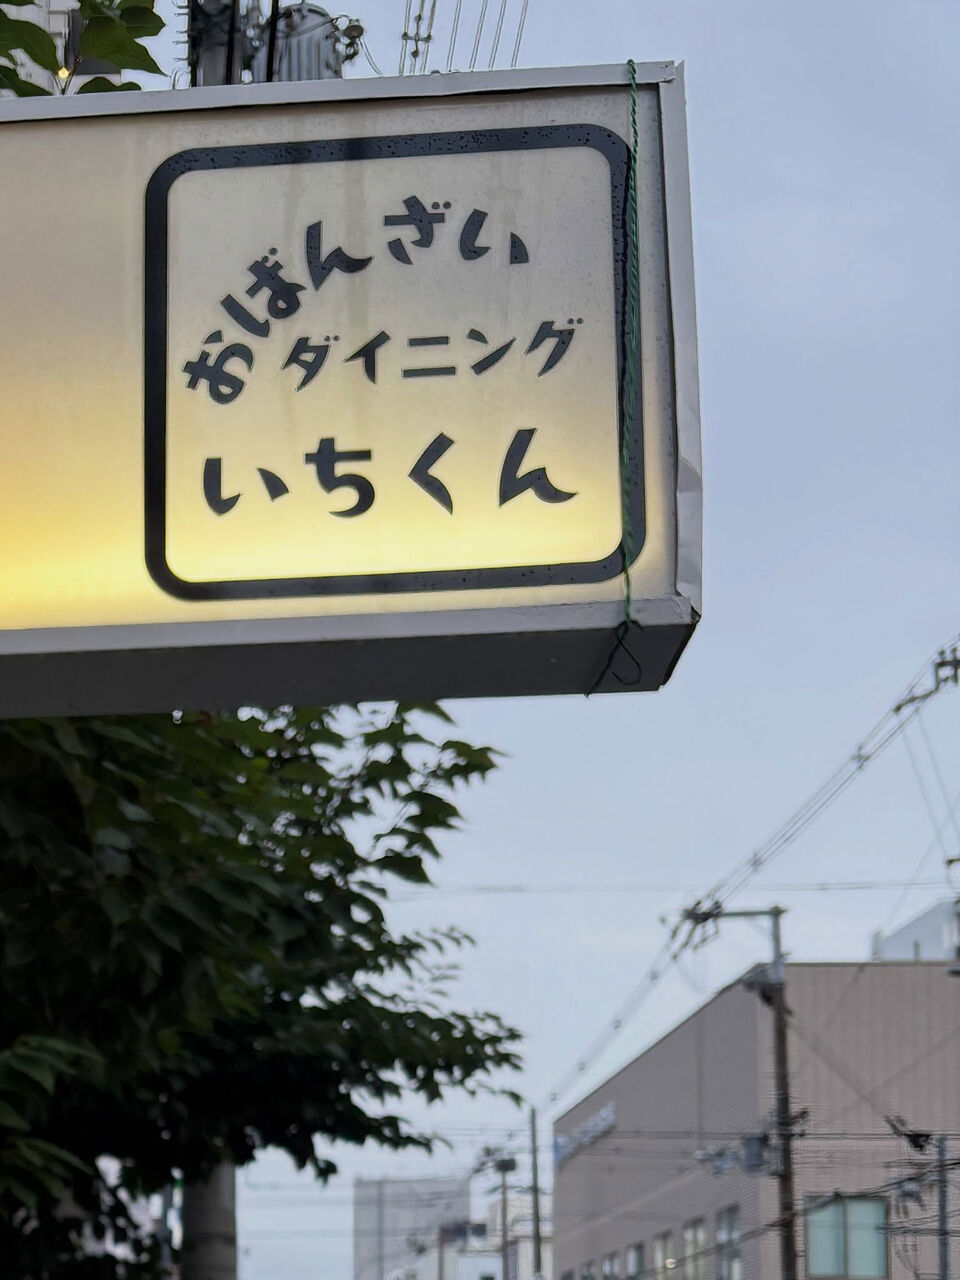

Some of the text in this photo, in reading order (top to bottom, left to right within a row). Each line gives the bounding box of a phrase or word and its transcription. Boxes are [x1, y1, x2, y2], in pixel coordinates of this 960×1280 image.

[182, 194, 530, 405] おばんざい
[282, 316, 585, 392] ダイニング
[203, 427, 577, 518] いちくん
